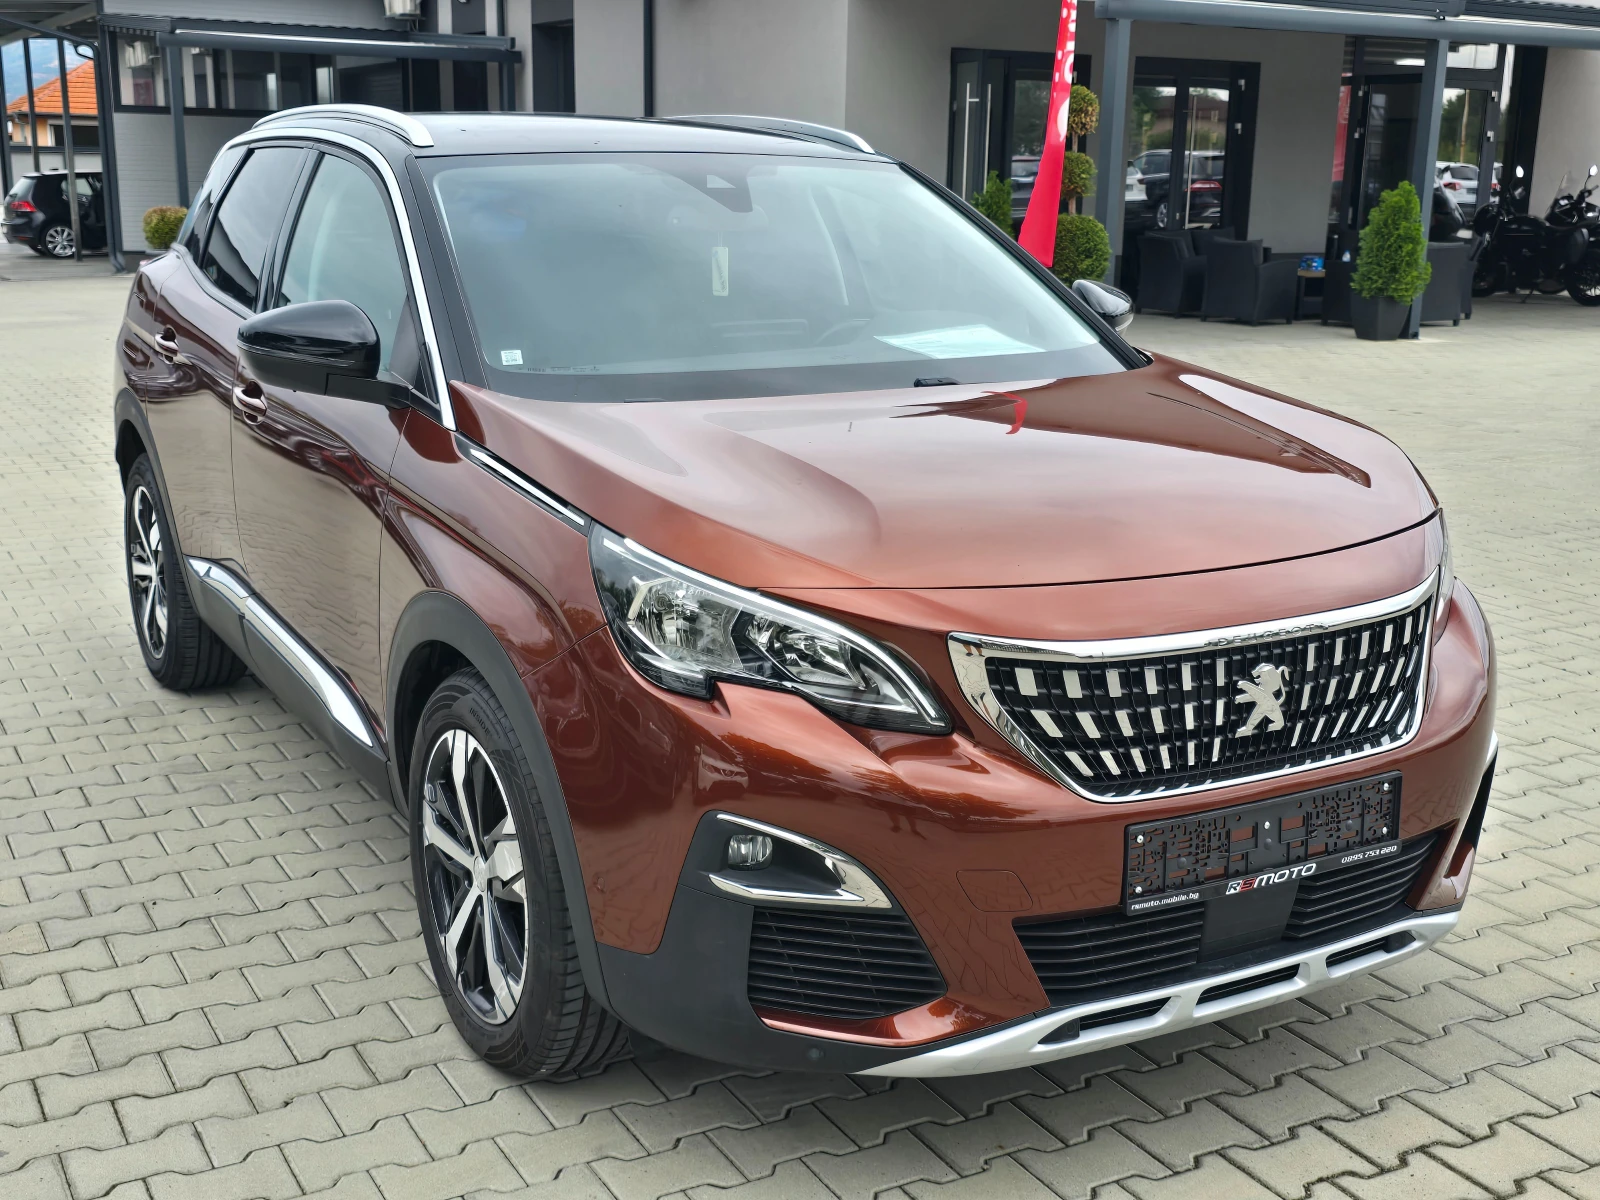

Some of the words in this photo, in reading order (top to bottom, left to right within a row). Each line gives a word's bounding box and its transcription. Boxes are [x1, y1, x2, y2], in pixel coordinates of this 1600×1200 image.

[470, 707, 490, 736] INSIDE
[1341, 852, 1363, 864] 0895
[1380, 845, 1397, 855] 220
[1225, 862, 1317, 895] RSMOTO
[1131, 892, 1200, 911] rsmoto.mobile.bg
